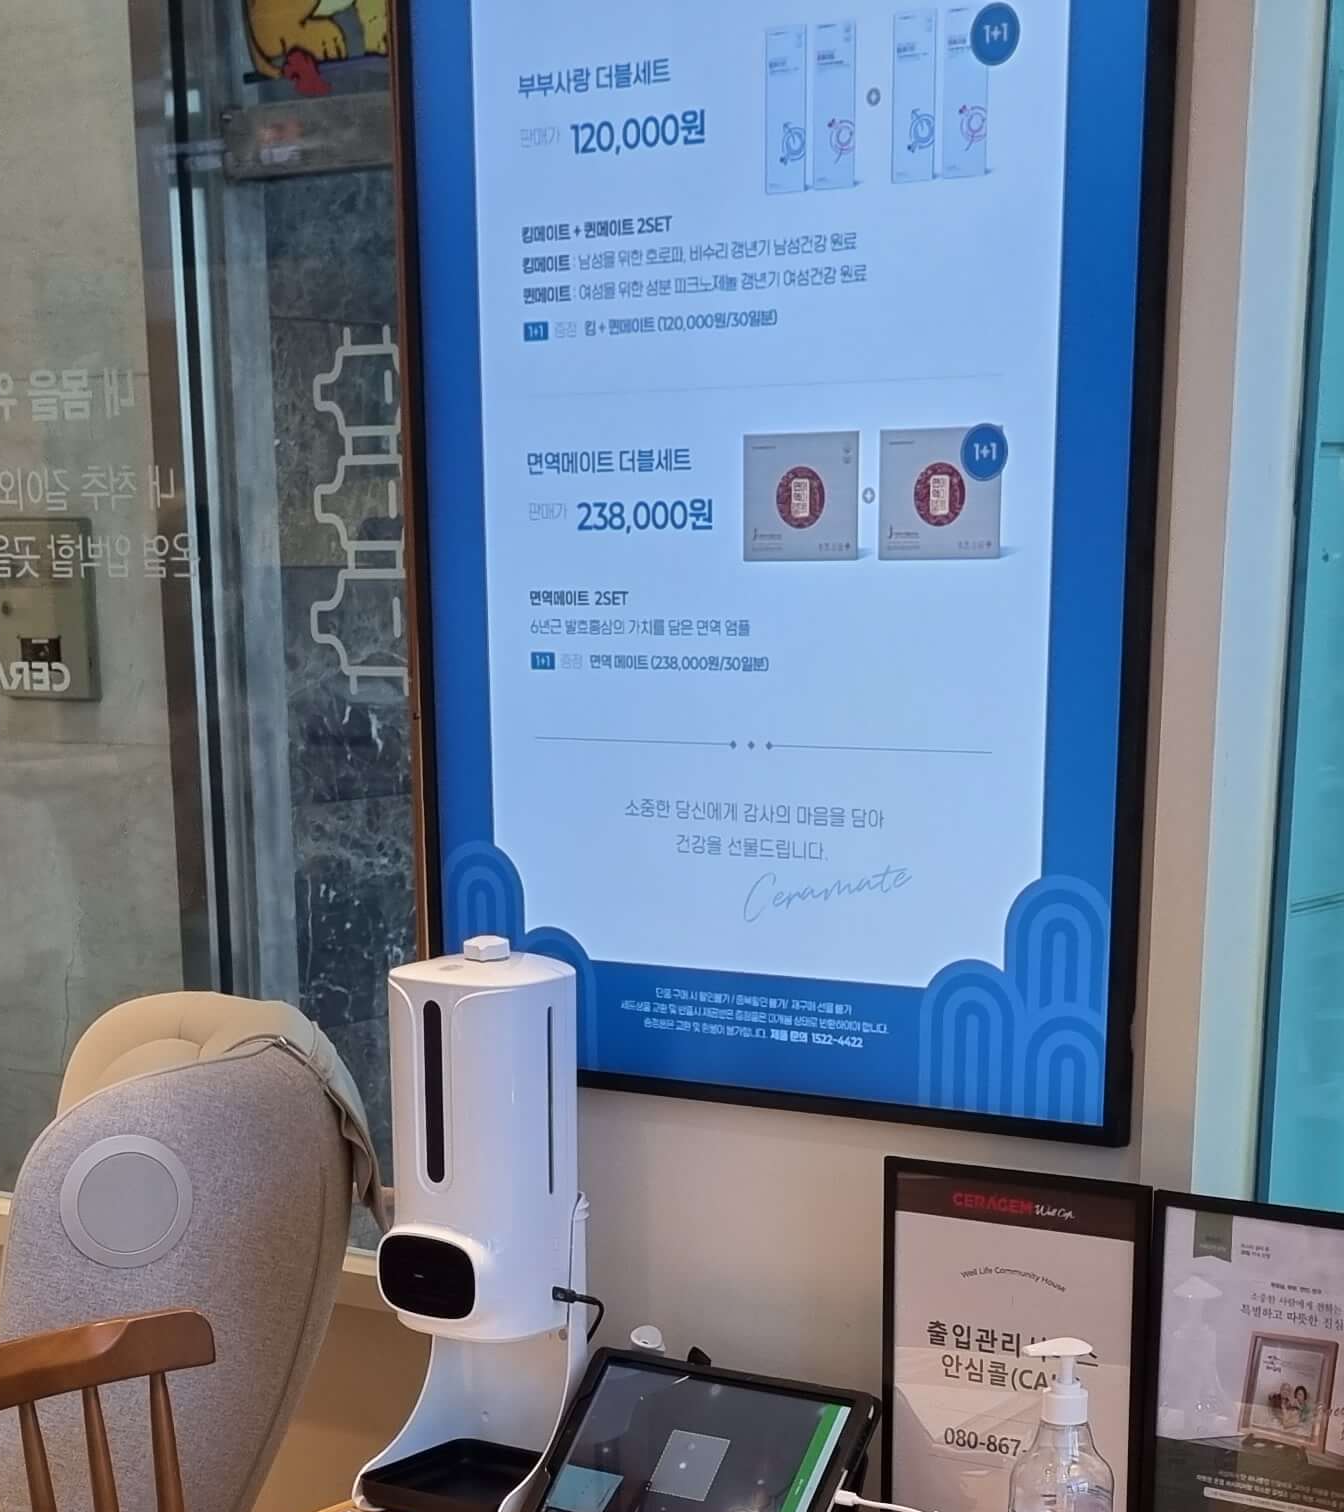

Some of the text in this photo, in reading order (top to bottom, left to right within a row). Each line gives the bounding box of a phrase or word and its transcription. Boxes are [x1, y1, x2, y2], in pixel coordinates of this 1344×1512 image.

[983, 22, 1009, 45] 1+1
[518, 58, 671, 99] 부부사랑 더블세트
[570, 109, 705, 155] 120,000원
[522, 223, 571, 243] 킹메이트
[584, 219, 635, 239] 퀸메이트
[637, 215, 673, 234] 2SET
[522, 255, 571, 274] 킹메이트
[618, 248, 643, 268] 위한
[689, 243, 728, 263] 비수리
[731, 240, 771, 259] 갱년기
[774, 234, 827, 257] 남성건강
[830, 232, 857, 251] 원료
[618, 279, 643, 299] 위한
[645, 277, 672, 297] 성분
[741, 270, 780, 291] 갱년기
[783, 265, 837, 287] 여성건강
[840, 263, 868, 283] 원료
[527, 448, 692, 476] 면역메이트 더블세트
[973, 442, 998, 463] 1+1
[576, 498, 713, 535] 238,000원
[529, 590, 629, 606] 면역메이트 2SET
[530, 619, 562, 635] 6년근
[668, 620, 694, 636] 담은
[697, 620, 722, 637] 면역
[590, 654, 613, 670] 면역
[614, 654, 650, 670] 메이트
[624, 798, 885, 830] 소중한 당신에게 감사의 마음을 담아
[676, 834, 829, 862] 건강을 선물드립니다.
[743, 864, 913, 923] Ceramate
[811, 1031, 864, 1048] 1522-4422
[953, 1192, 1034, 1215] CERAGEM
[961, 1266, 1067, 1293] Well Life Community House
[927, 1320, 1021, 1359] 출입관리
[941, 1353, 1080, 1392] 안심콜(CA
